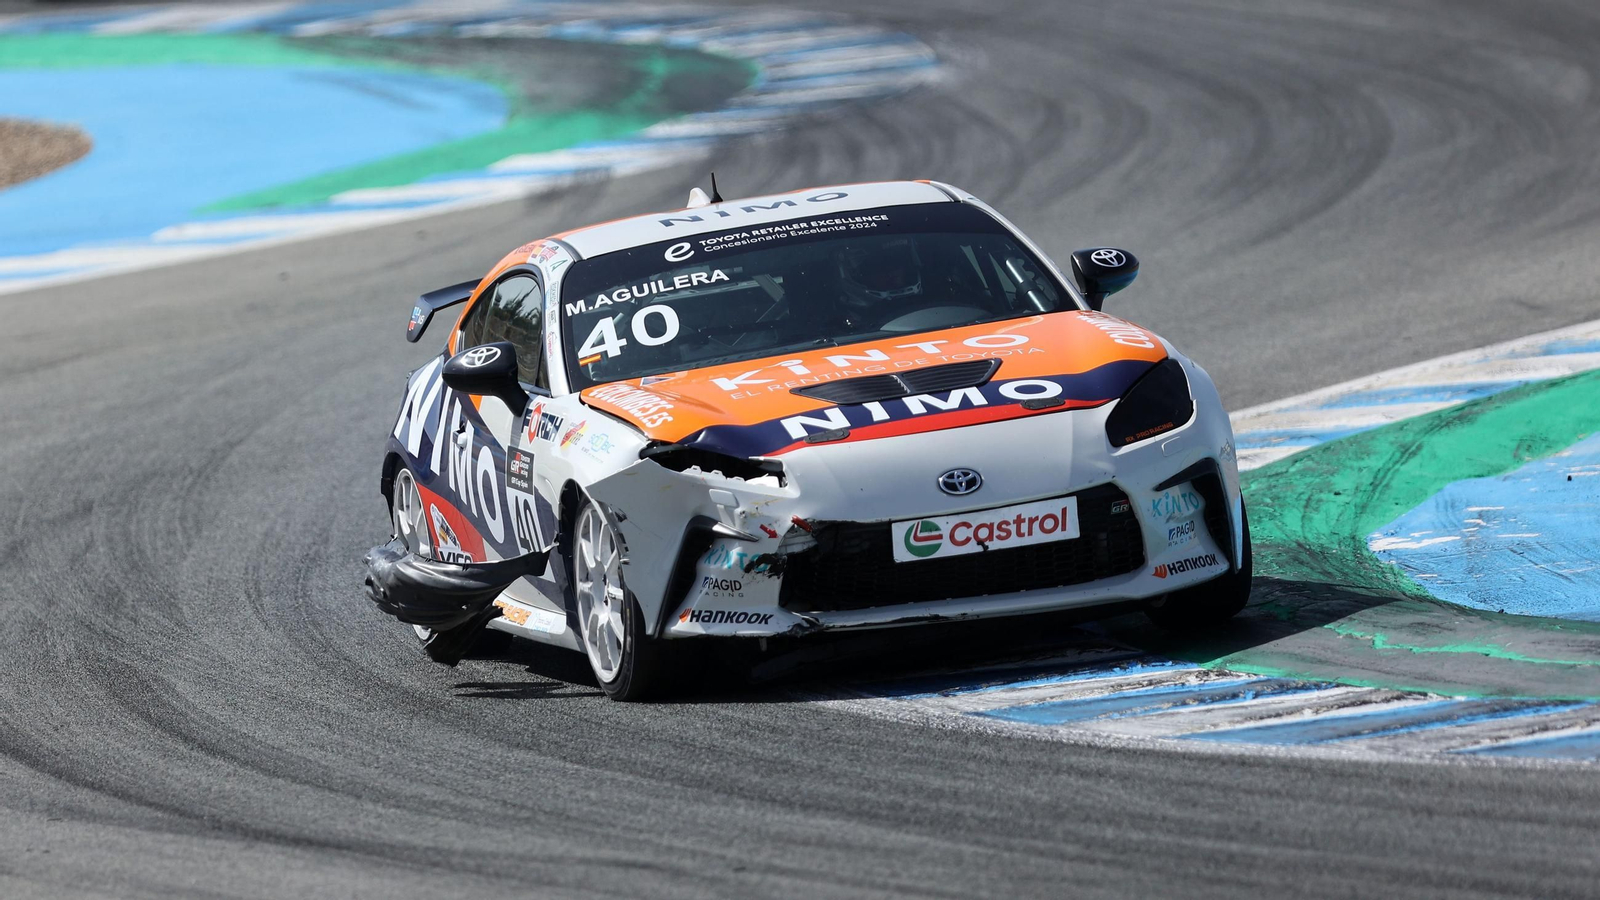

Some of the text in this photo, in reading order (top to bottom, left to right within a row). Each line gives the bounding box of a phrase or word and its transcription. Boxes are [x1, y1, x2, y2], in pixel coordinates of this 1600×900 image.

[657, 191, 849, 228] NIMO
[699, 214, 889, 247] TOYOTA RETAILER EXCELLENCE
[703, 221, 878, 253] Concesionario Excelente 2024
[564, 268, 730, 317] M.AGUILERA
[577, 304, 680, 360] 40
[730, 347, 1046, 399] EL RENTING DE TOYOTA
[780, 379, 1063, 440] NIMO
[394, 356, 505, 545] NIMO
[949, 506, 1068, 547] Castrol
[1176, 520, 1195, 538] PAGID
[708, 576, 743, 592] PAGID
